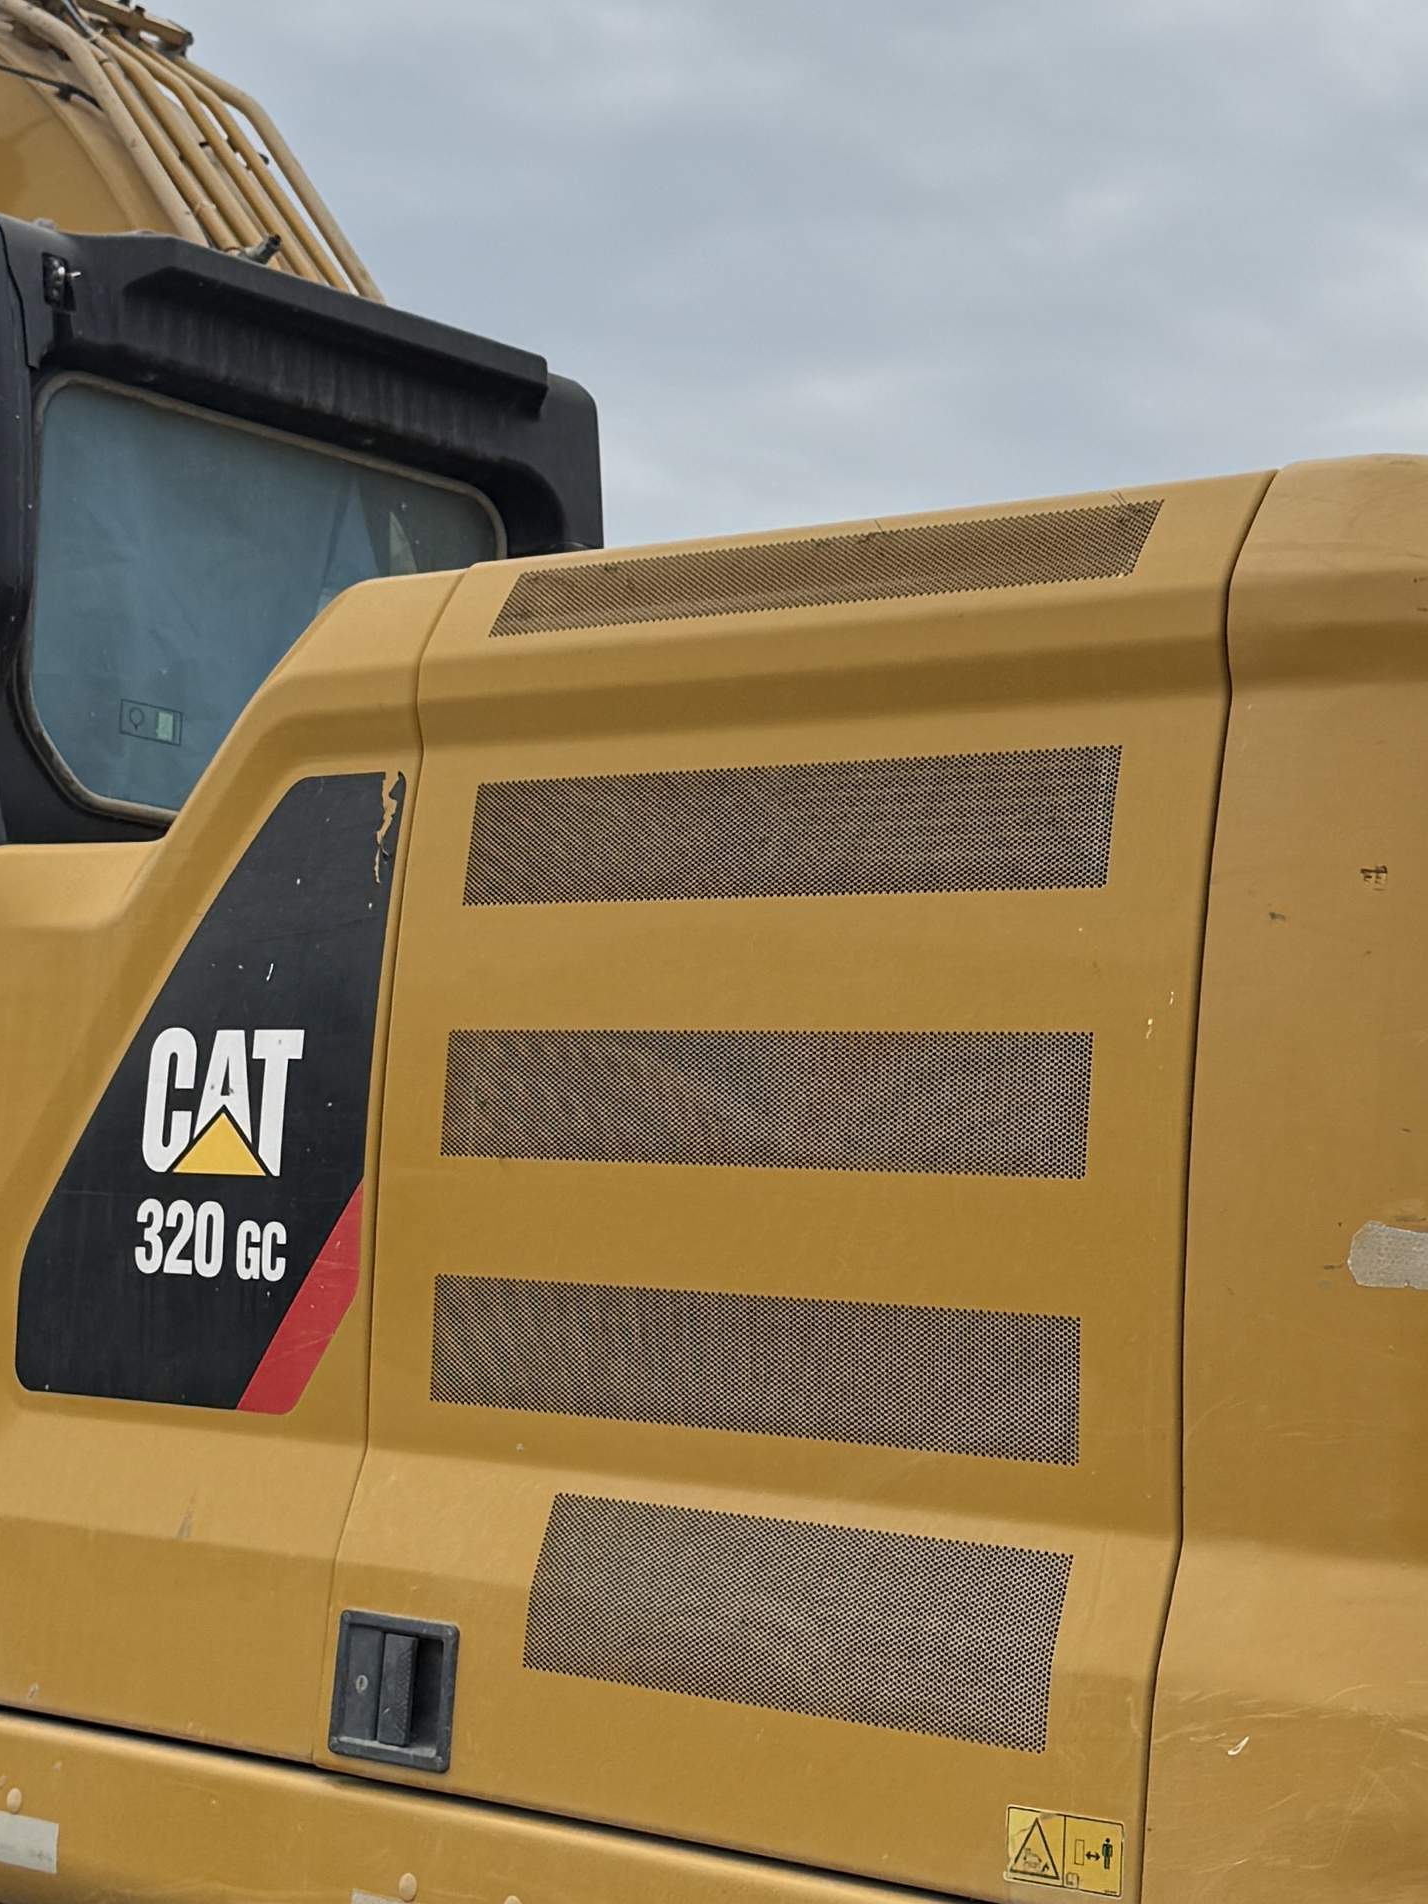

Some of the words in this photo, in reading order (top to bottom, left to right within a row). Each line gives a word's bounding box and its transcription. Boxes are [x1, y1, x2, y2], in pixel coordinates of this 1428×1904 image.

[141, 1027, 305, 1177] CAT
[135, 1197, 224, 1278] 320
[235, 1220, 287, 1281] GC
